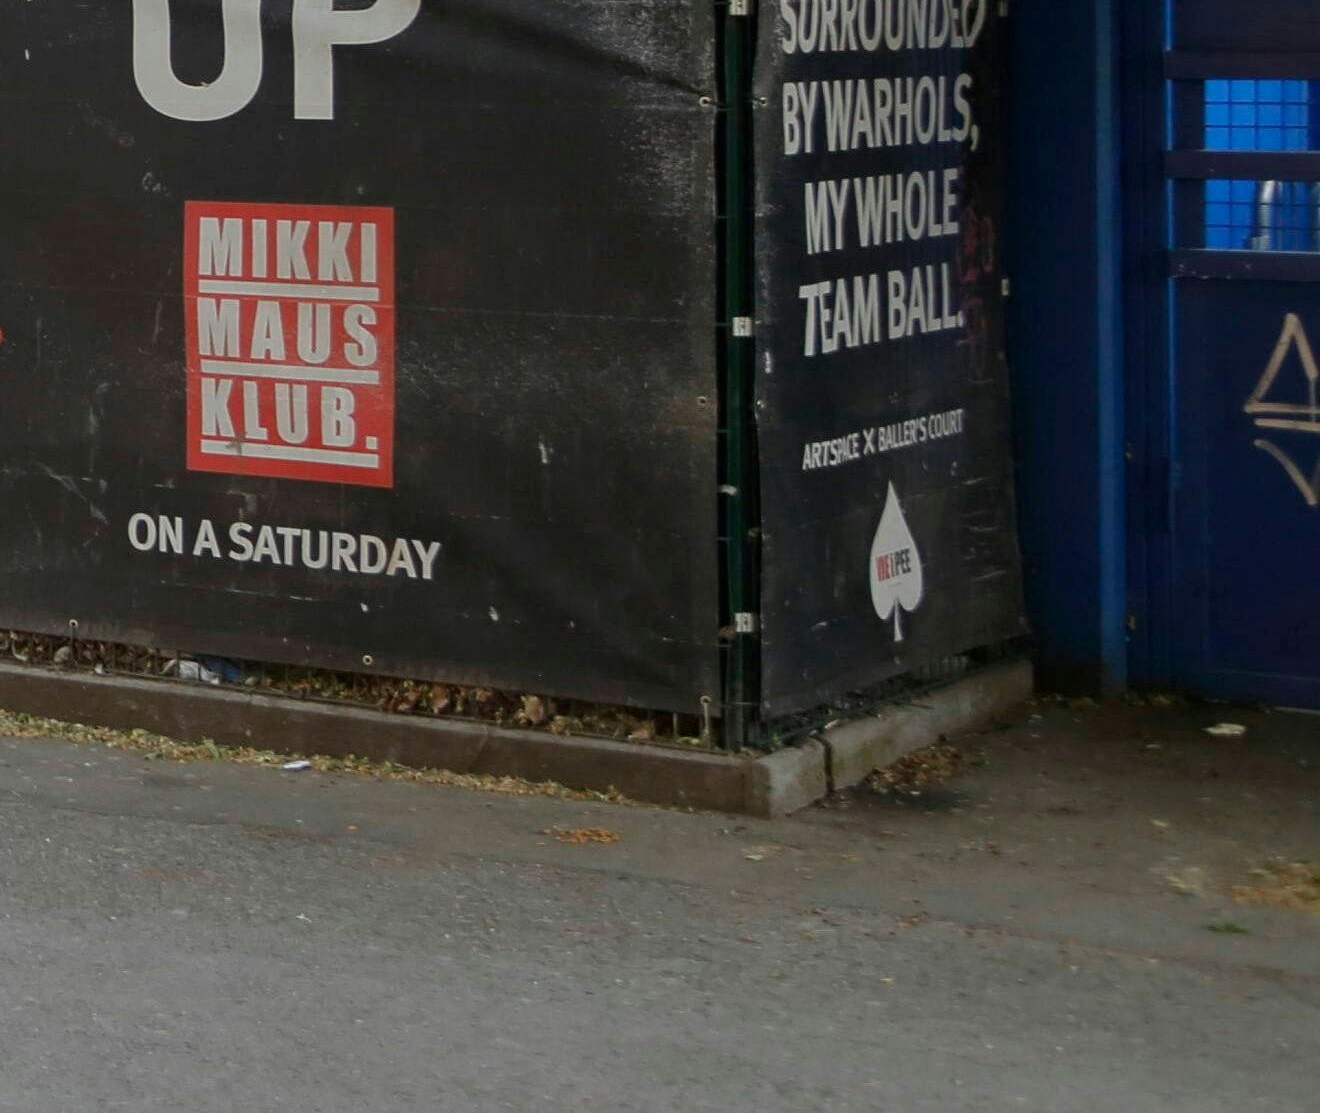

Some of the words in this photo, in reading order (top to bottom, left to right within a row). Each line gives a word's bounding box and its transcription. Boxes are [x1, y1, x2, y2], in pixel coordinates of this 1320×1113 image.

[782, 81, 819, 155] BY
[821, 73, 979, 152] WARHOLS,
[804, 178, 849, 255] MY
[853, 168, 960, 248] WHOLE
[197, 216, 378, 284] MIKKI
[196, 296, 379, 368] MAUS
[798, 273, 881, 357] TEAM
[887, 262, 966, 340] BALL.
[200, 376, 380, 452] KLUB.
[801, 432, 860, 470] ARTSPACE
[927, 408, 964, 440] COURT
[127, 512, 184, 555] ON
[192, 519, 222, 558] A
[228, 521, 441, 580] SATURDAY
